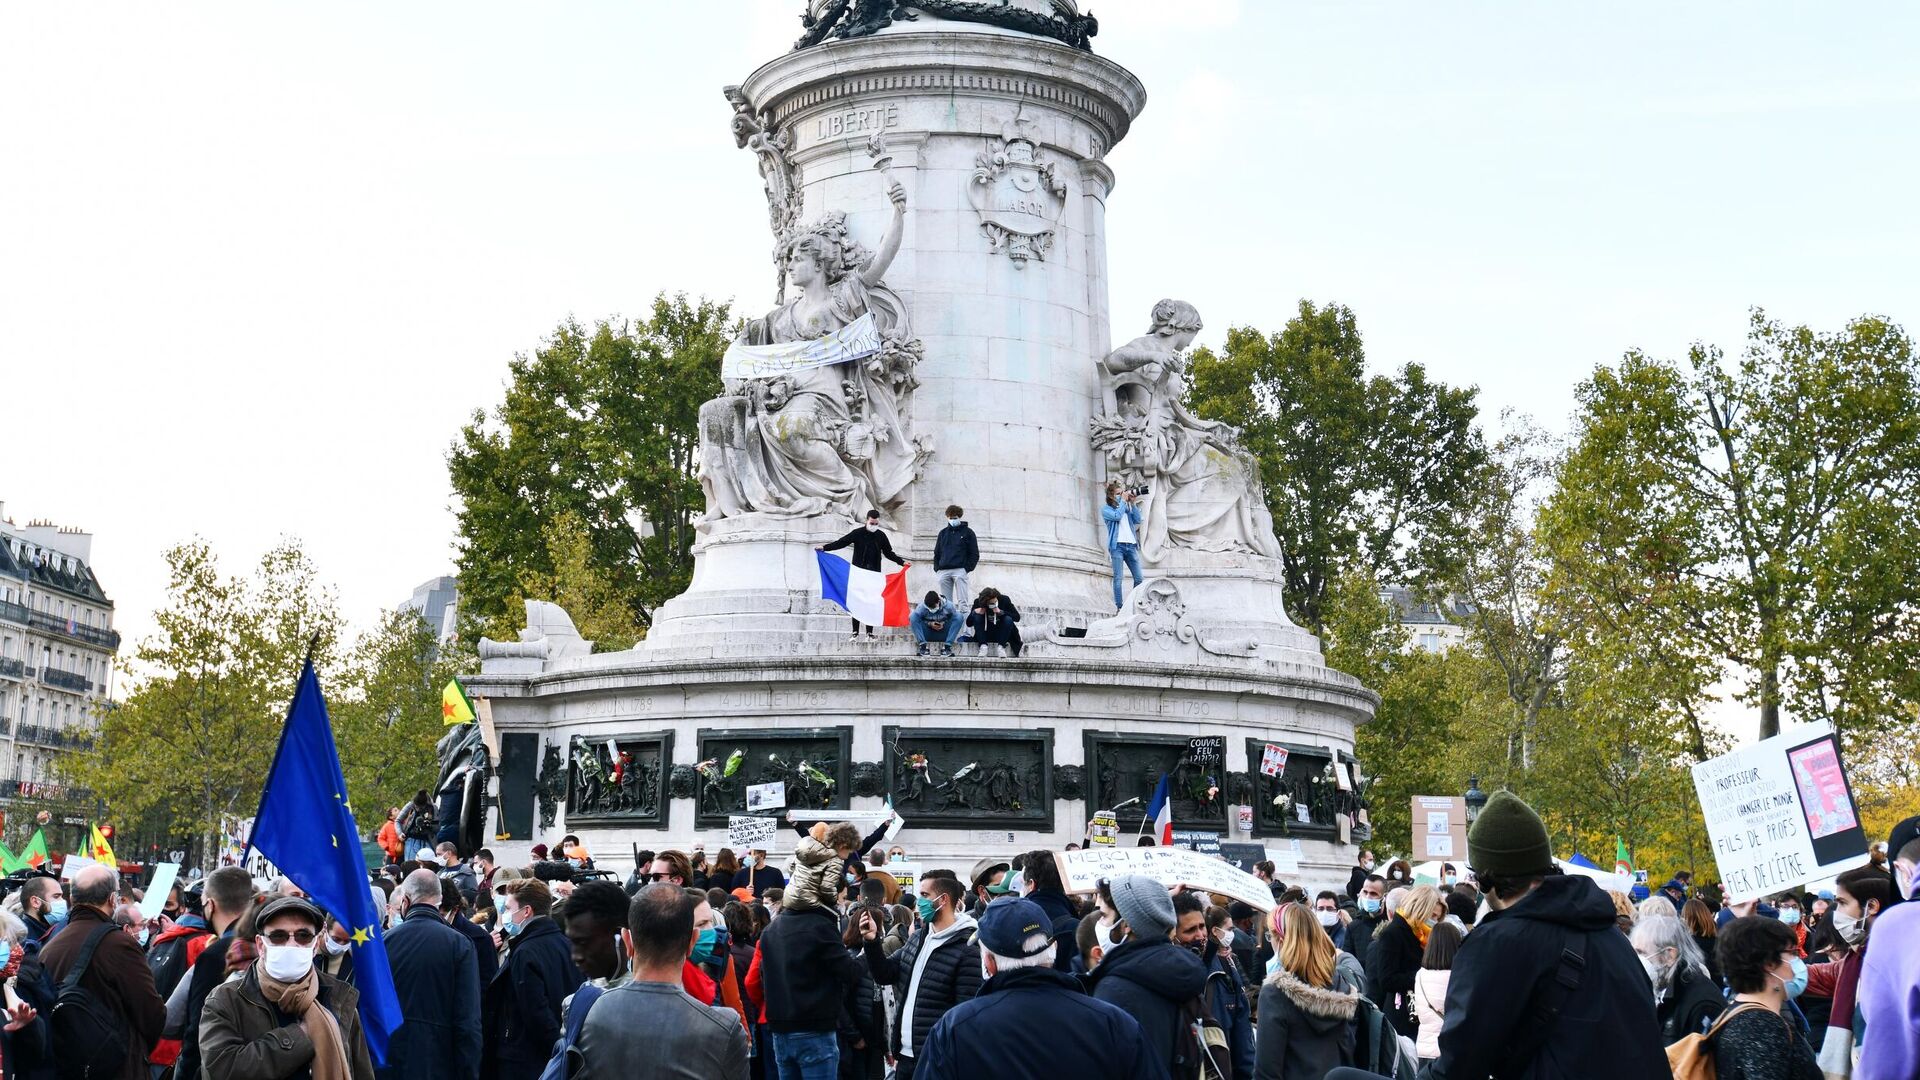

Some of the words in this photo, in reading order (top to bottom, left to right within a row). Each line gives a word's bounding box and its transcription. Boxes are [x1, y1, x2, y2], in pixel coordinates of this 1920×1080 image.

[816, 102, 899, 141] LIBERTÉ
[998, 199, 1047, 217] LABOR
[601, 699, 626, 714] JUIN
[630, 697, 655, 712] 1789
[719, 693, 731, 708] 14
[735, 692, 794, 708] JUILLET
[797, 691, 829, 707] 1789
[991, 693, 1024, 708] 1789
[1106, 696, 1120, 713] 14
[1124, 696, 1178, 715] JUILLET
[1181, 700, 1211, 716] 1790
[1190, 738, 1221, 748] COUVRE
[1197, 747, 1213, 755] FEU
[1715, 767, 1761, 792] PROFESSEUR
[1736, 799, 1762, 818] CHANGER
[1761, 797, 1771, 811] LE
[1771, 791, 1794, 808] MONDE
[1093, 835, 1108, 843] POUR
[1747, 829, 1762, 848] DE
[1766, 817, 1798, 842] PROFS
[1067, 851, 1130, 864] MERCI
[1099, 862, 1115, 870] QUI
[1725, 868, 1752, 895] FIER
[1753, 863, 1769, 889] DE
[1769, 852, 1806, 885] L'ÊTRE
